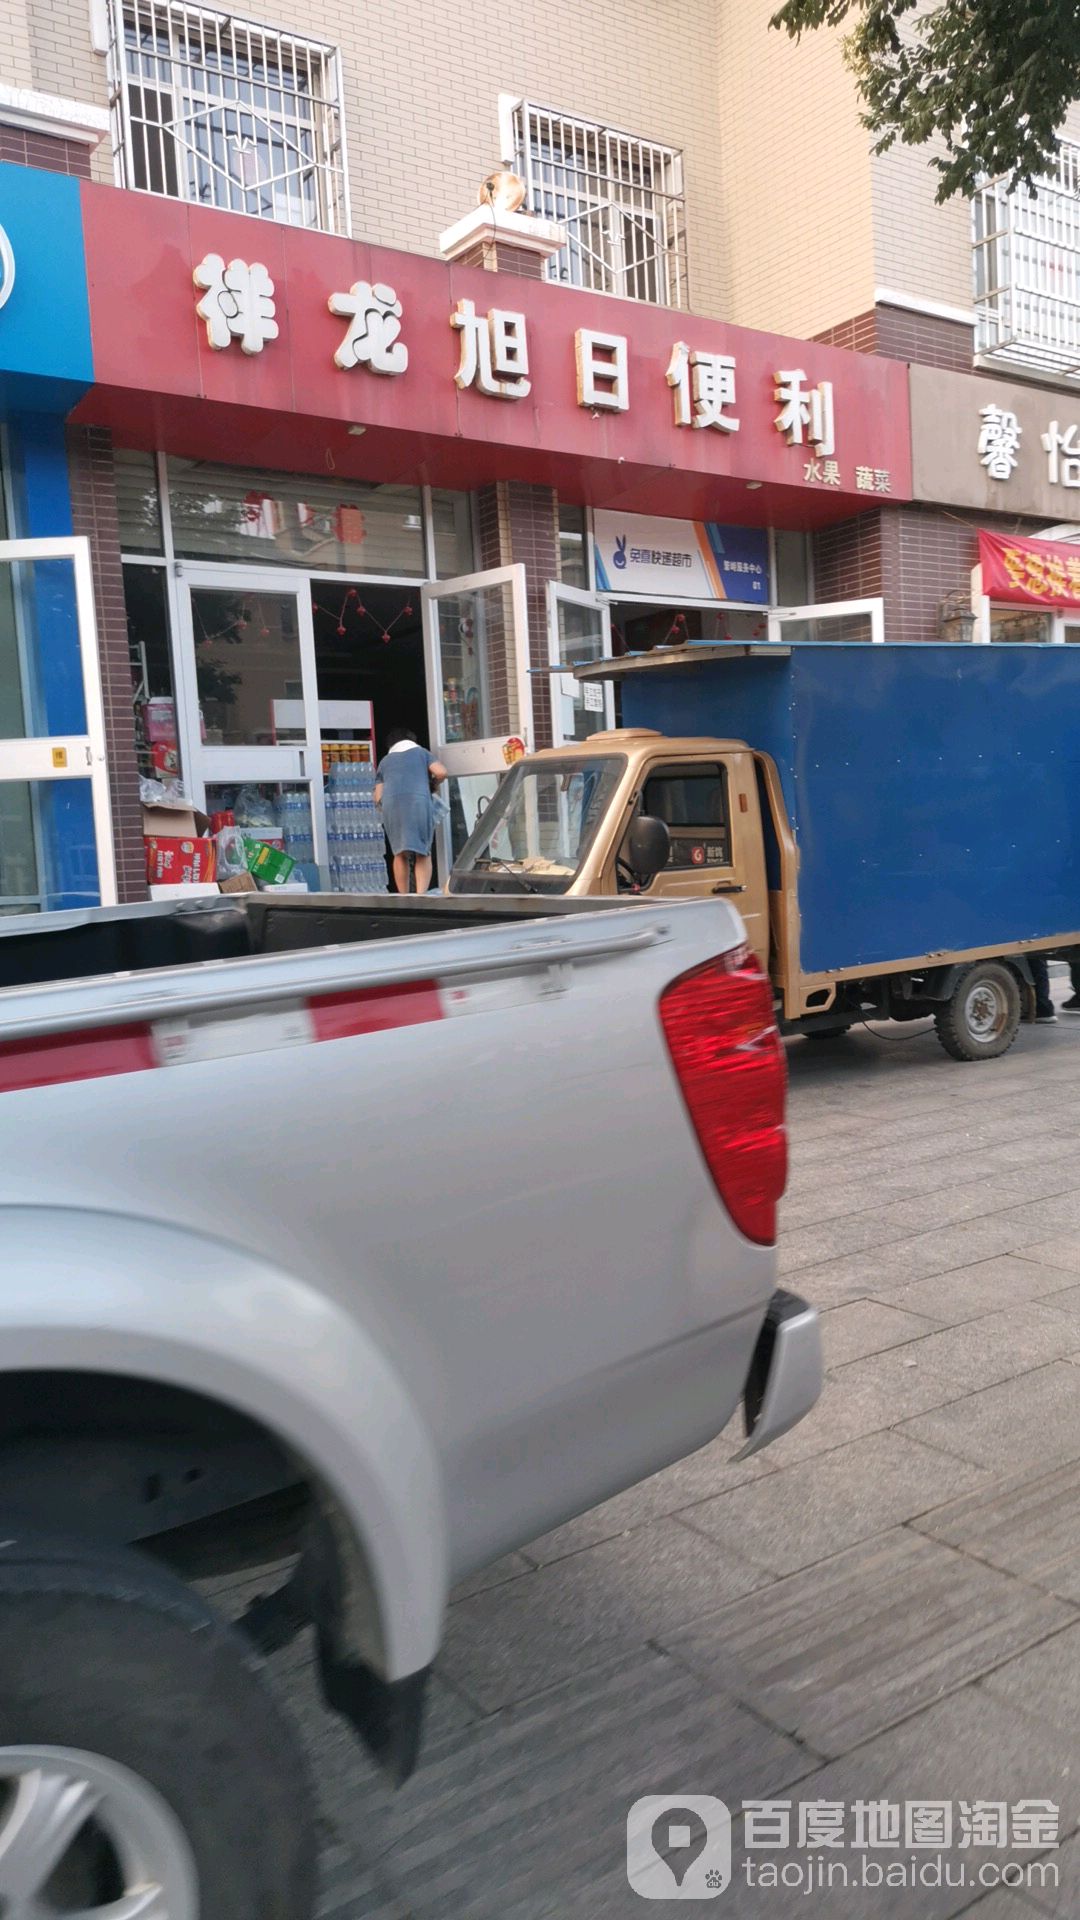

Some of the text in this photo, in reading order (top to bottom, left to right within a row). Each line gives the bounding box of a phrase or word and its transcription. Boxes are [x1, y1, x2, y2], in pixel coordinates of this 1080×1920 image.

[193, 252, 836, 458] 祥龙旭日便利
[803, 457, 891, 493] 水果 蔬菜
[977, 404, 1080, 487] 馨怡
